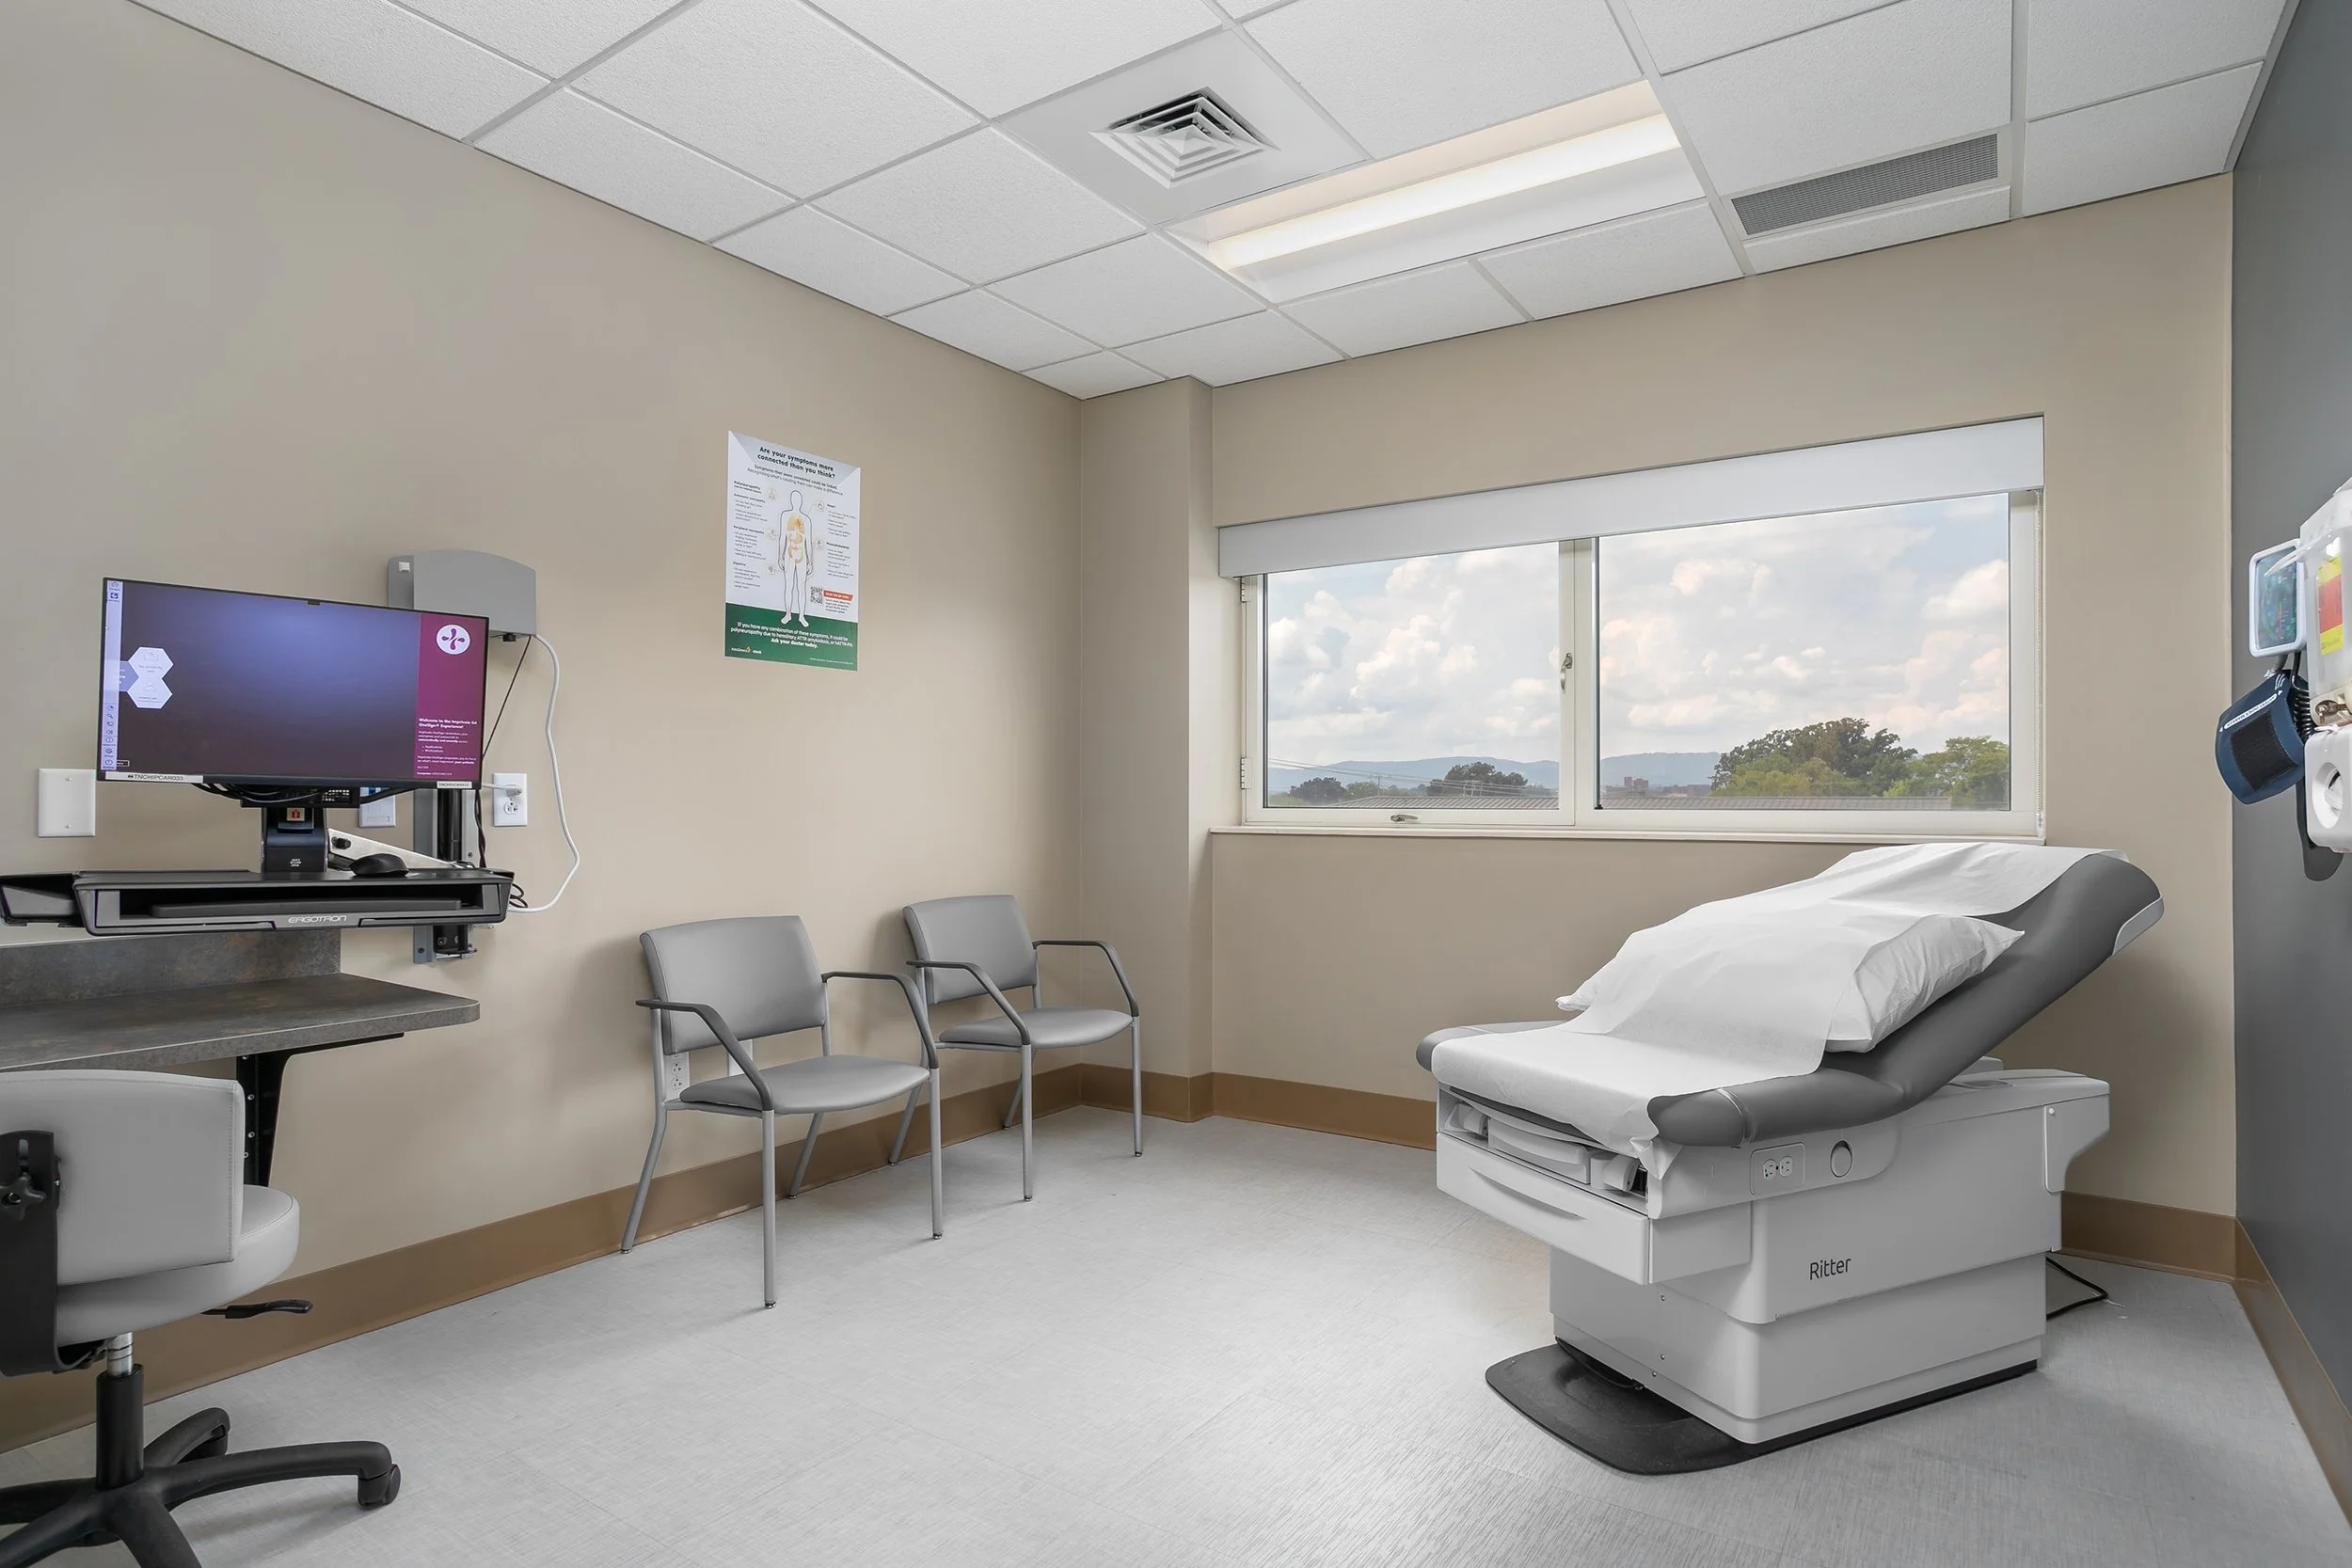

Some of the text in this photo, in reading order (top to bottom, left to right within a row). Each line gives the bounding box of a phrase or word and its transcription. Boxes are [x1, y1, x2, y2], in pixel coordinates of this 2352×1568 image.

[757, 453, 788, 467] connected
[789, 462, 804, 471] than
[817, 469, 835, 479] think?
[771, 450, 786, 459] your
[787, 454, 818, 467] symptoms
[818, 463, 834, 472] more
[1810, 1258, 1851, 1280] Ritter
